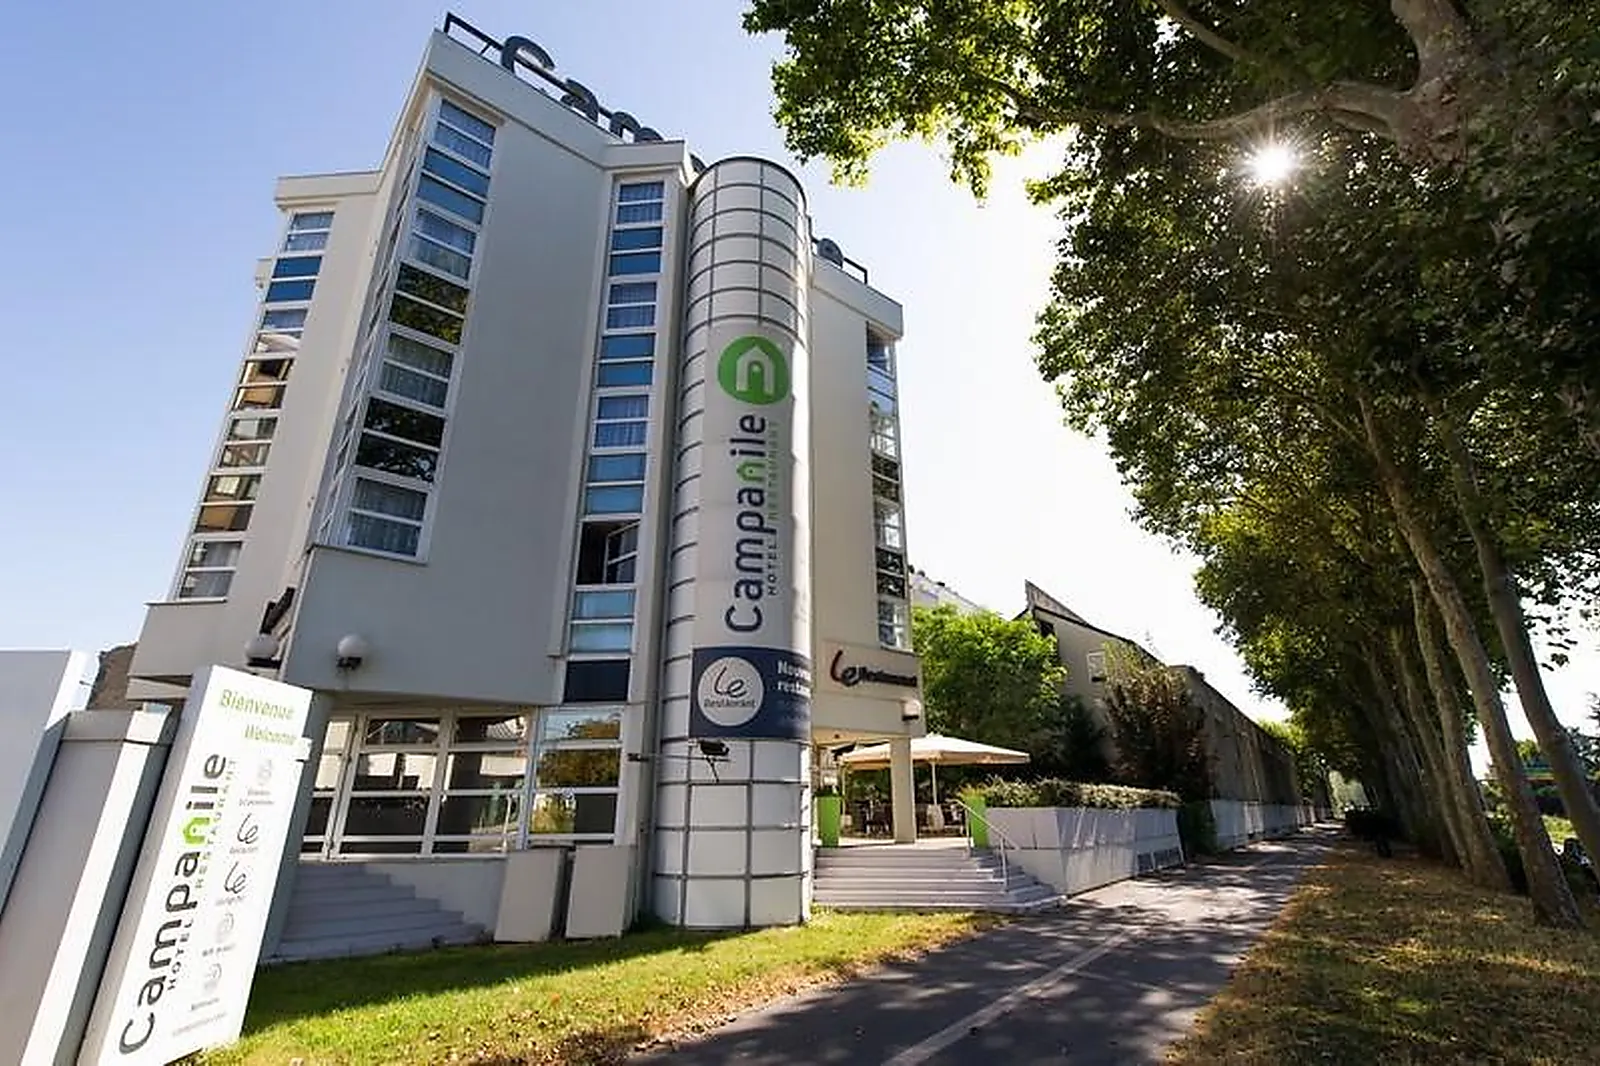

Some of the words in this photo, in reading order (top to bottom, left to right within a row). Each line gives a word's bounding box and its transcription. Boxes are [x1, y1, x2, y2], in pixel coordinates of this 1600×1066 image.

[725, 413, 778, 632] Campanile
[768, 538, 778, 596] HOTEL
[714, 666, 748, 698] Le
[220, 688, 295, 720] Bienvenue
[237, 812, 259, 845] Le
[224, 860, 247, 894] Le
[119, 754, 227, 1055] Campanile
